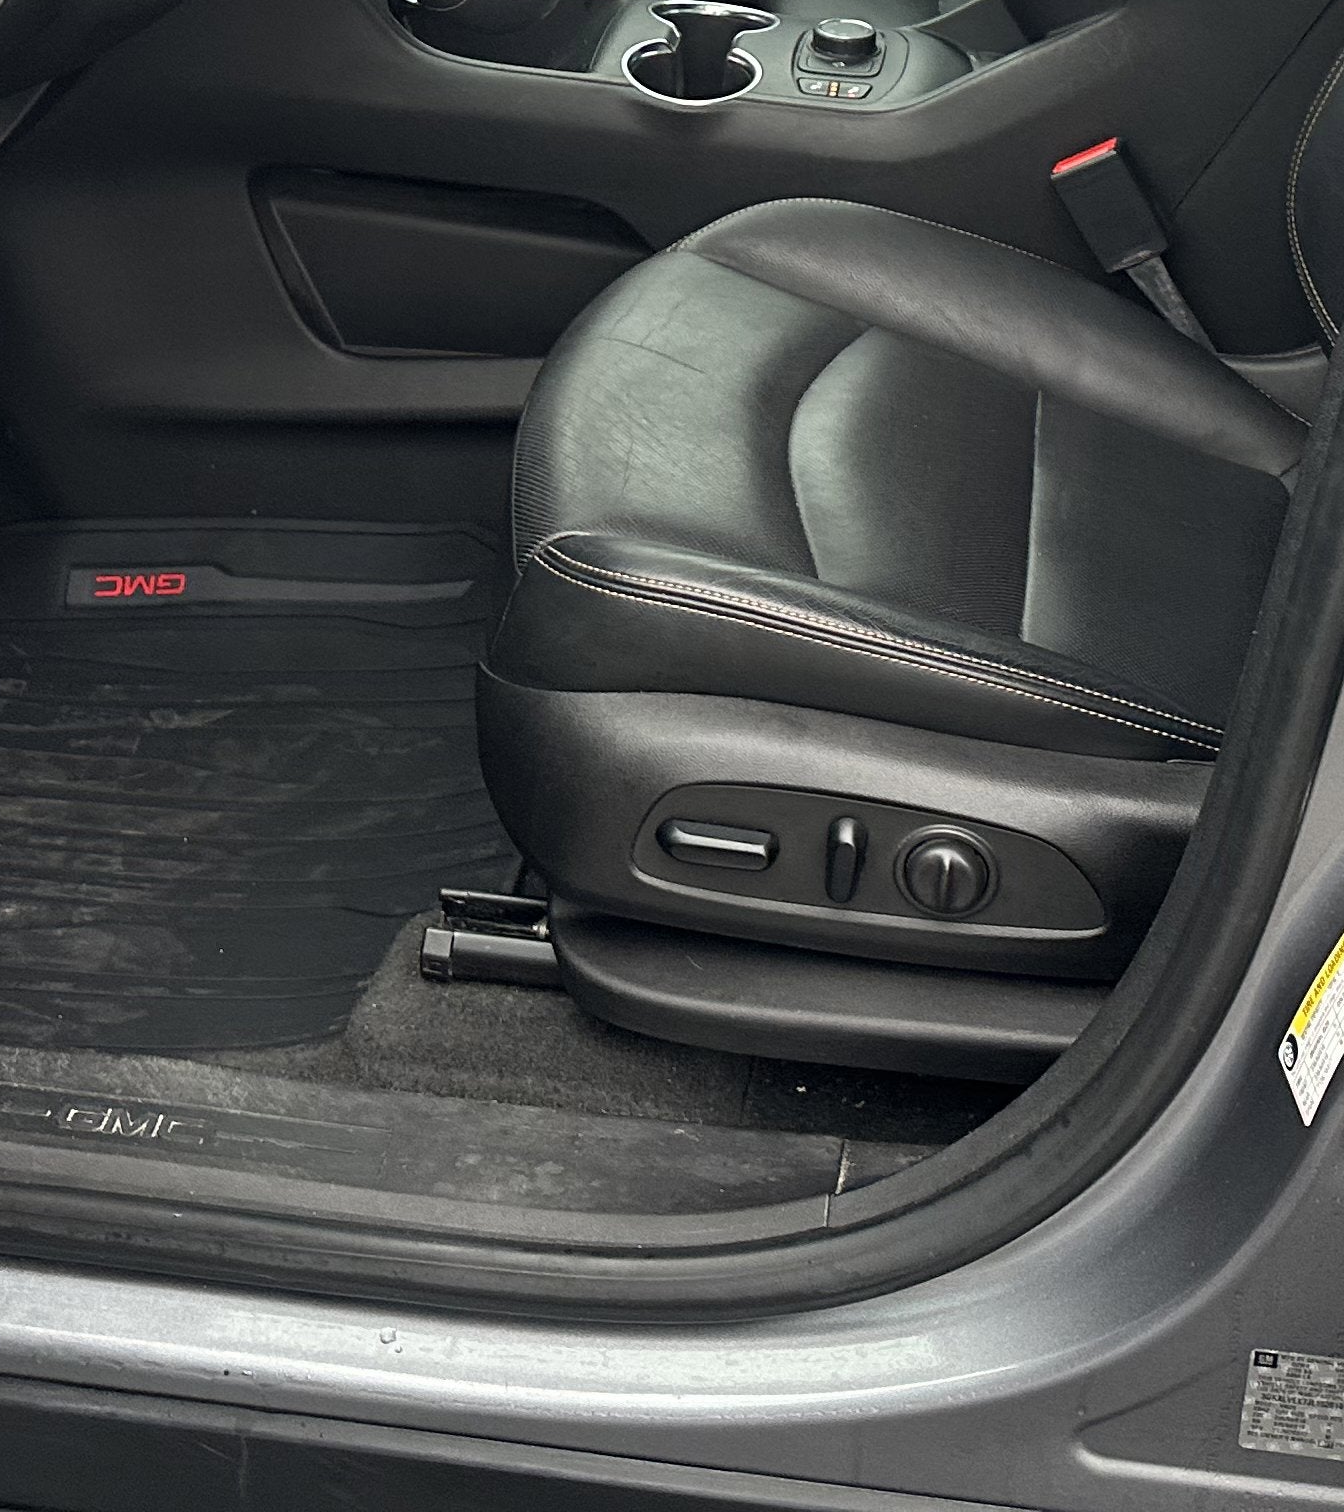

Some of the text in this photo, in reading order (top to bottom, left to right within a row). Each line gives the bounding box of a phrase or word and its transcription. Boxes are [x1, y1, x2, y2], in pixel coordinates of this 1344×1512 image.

[93, 572, 186, 598] GMC
[1313, 976, 1326, 999] AND
[58, 1107, 207, 1145] GMC
